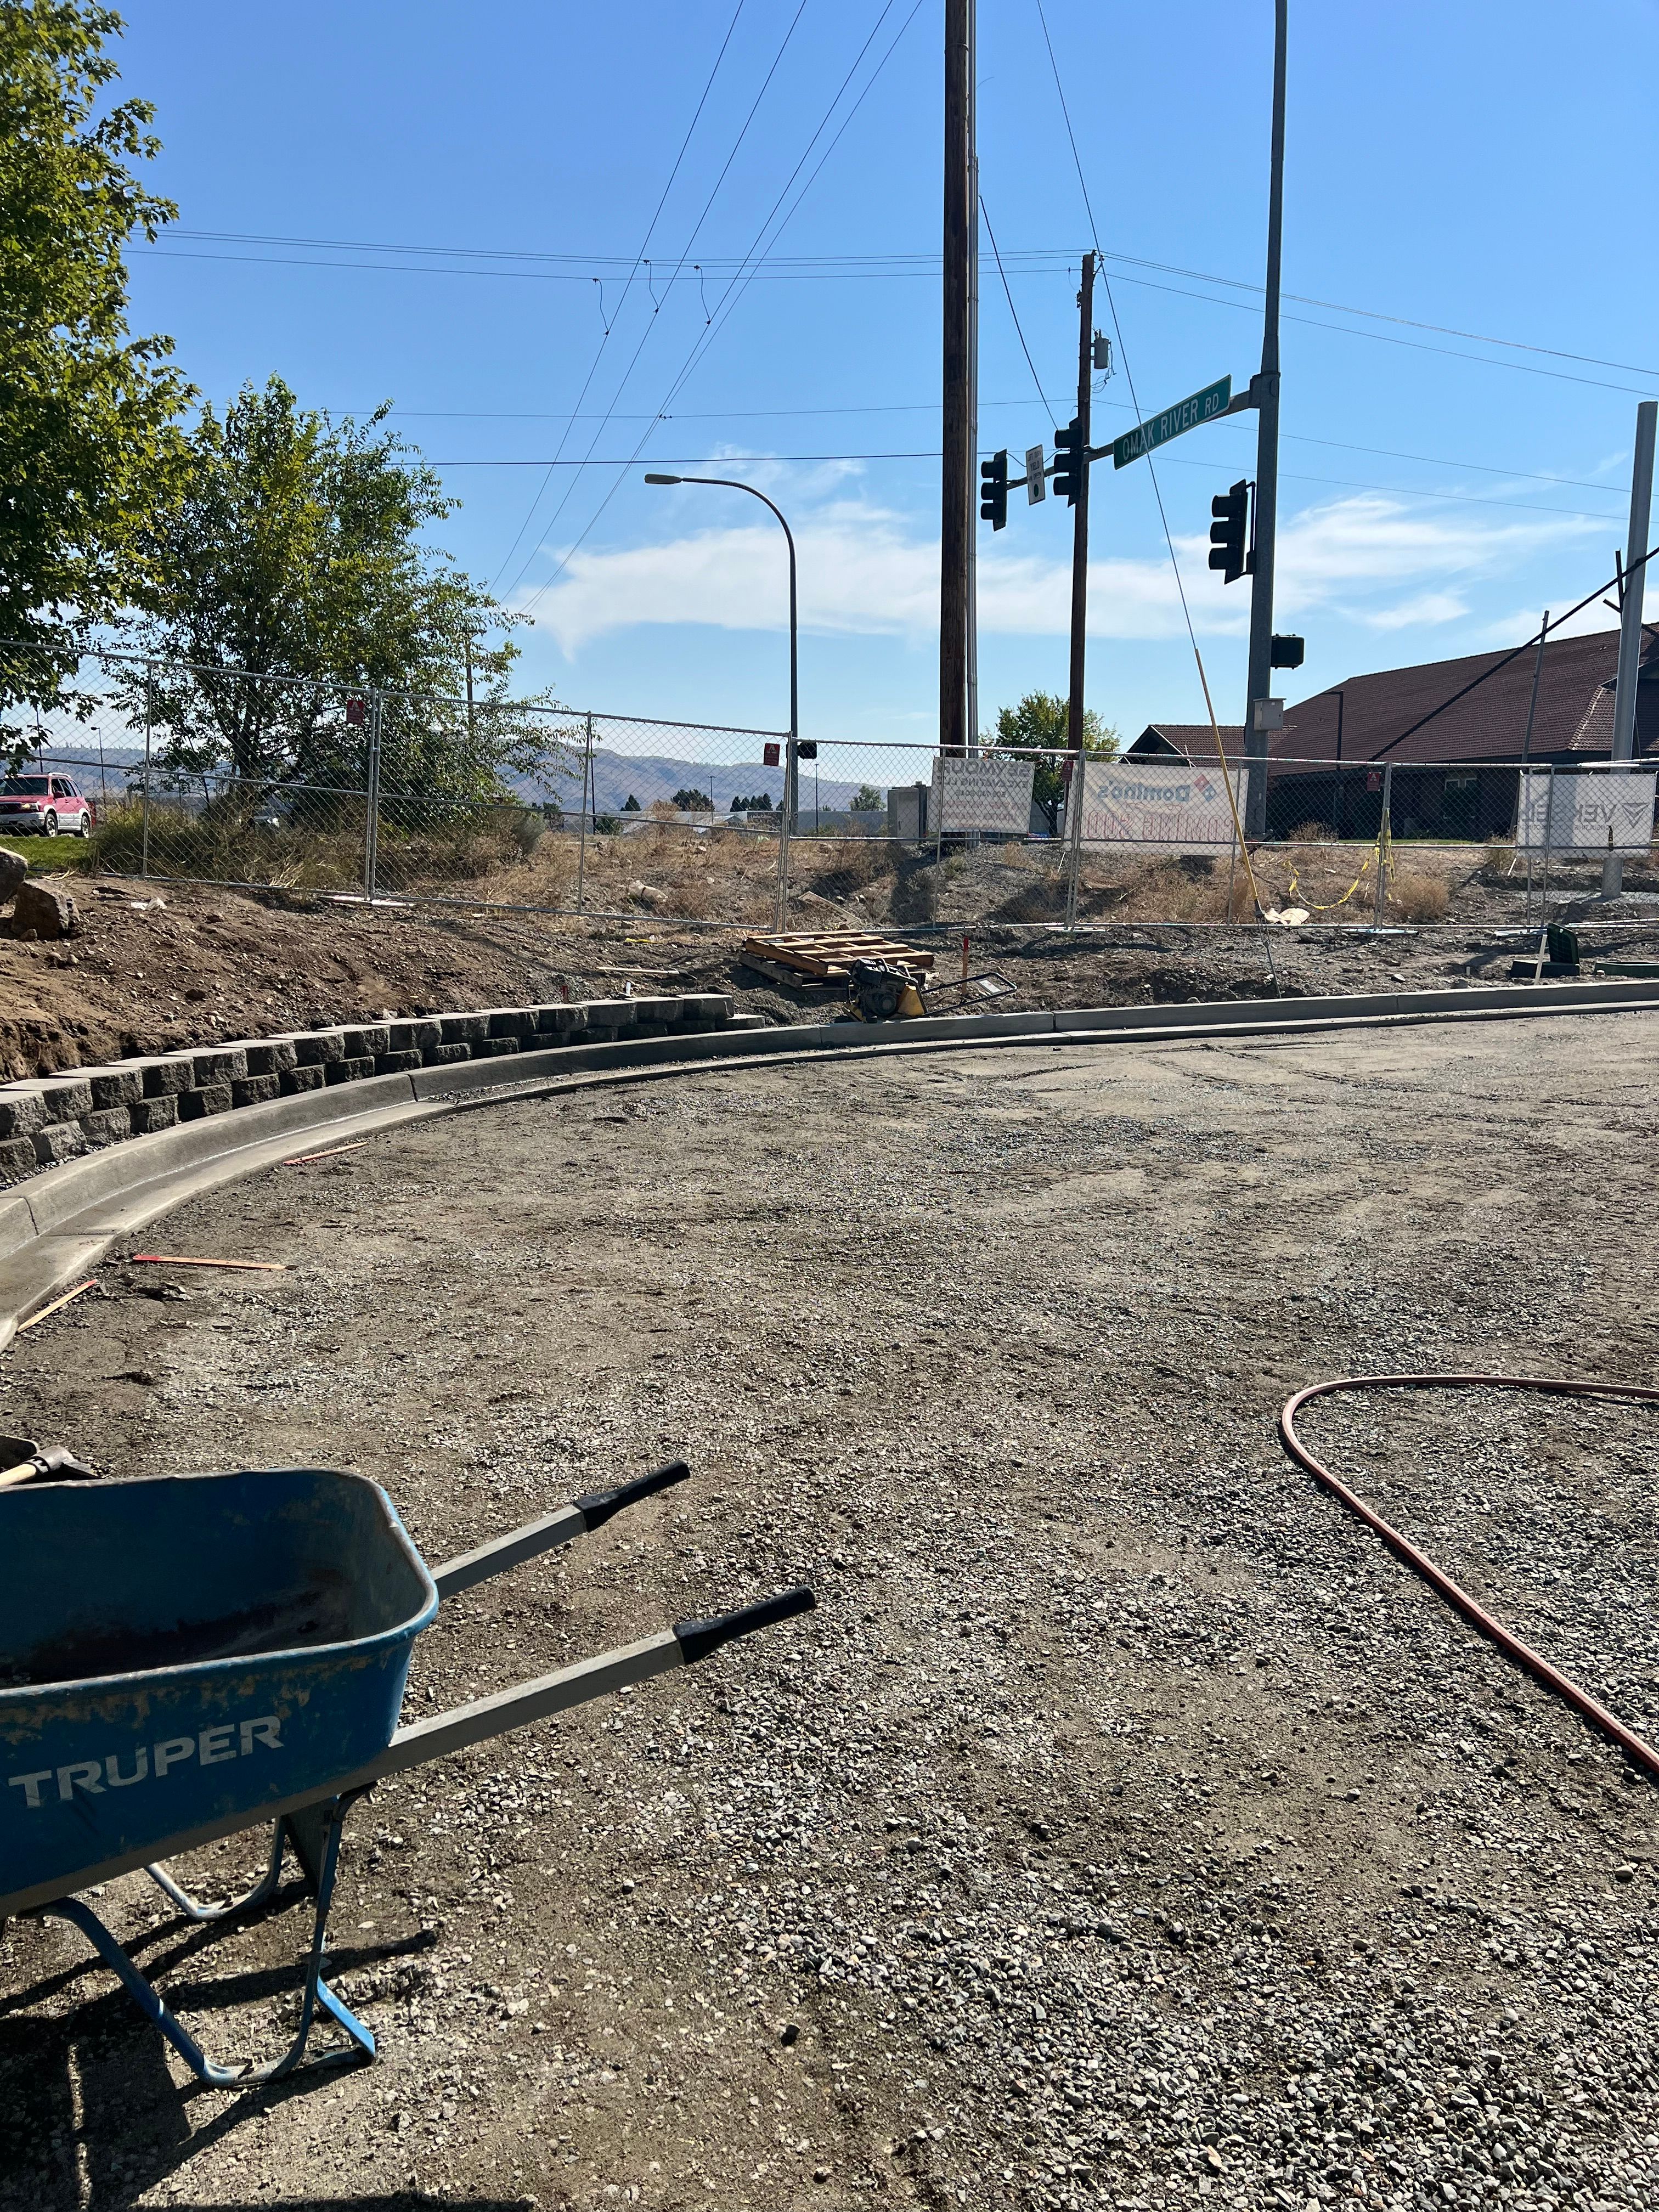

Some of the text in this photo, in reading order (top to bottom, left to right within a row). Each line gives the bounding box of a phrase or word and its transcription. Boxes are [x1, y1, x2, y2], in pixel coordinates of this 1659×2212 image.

[1122, 393, 1220, 461] OMAK RIVER RD
[8, 1715, 285, 1808] TRUPER
